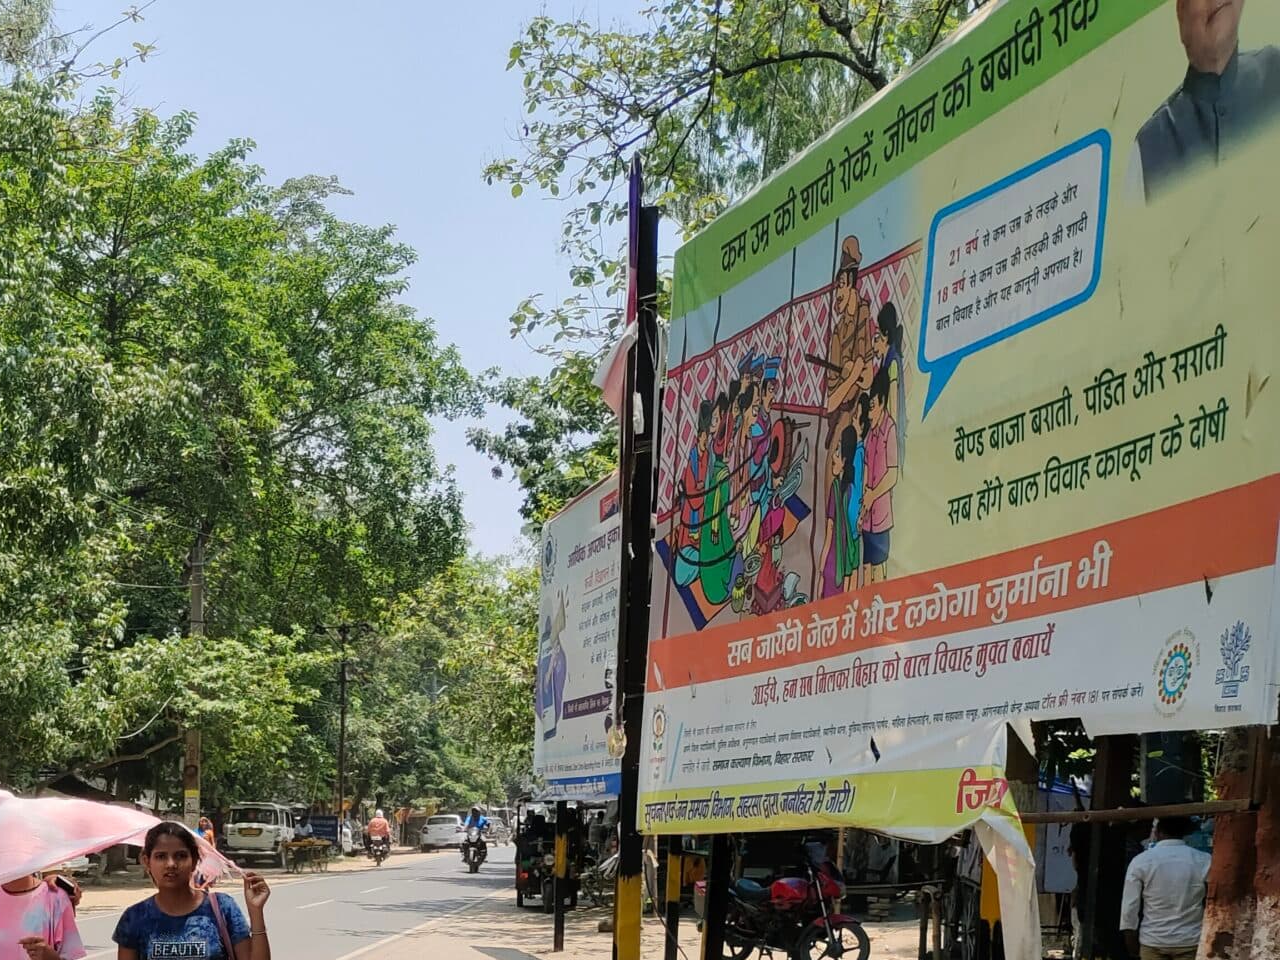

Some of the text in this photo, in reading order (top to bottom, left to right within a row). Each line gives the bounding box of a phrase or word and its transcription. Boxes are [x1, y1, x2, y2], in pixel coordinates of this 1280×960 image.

[721, 230, 747, 272] कम
[774, 186, 797, 236] की
[800, 158, 835, 221] शादी
[883, 92, 938, 162] जीवन
[942, 56, 974, 117] की
[978, 7, 1044, 92] बर्बादी
[949, 247, 960, 266] 21
[993, 224, 1006, 242] कम
[937, 286, 948, 304] 18
[988, 412, 1026, 451] बाजा
[1030, 386, 1079, 435] बराती,
[1083, 368, 1127, 416] पंडित
[1132, 351, 1166, 398] और
[1170, 323, 1227, 384] सराती
[947, 397, 1229, 525] सब होंगे बाल विवाह कानून के दोषी
[727, 540, 1113, 667] सब जायेंगे जेल में और लगेगा जुर्माना भी
[852, 656, 879, 688] बिहार
[882, 652, 900, 685] को
[903, 652, 929, 678] बाल
[934, 641, 972, 675] विवाह
[154, 943, 203, 956] BEAUTY
